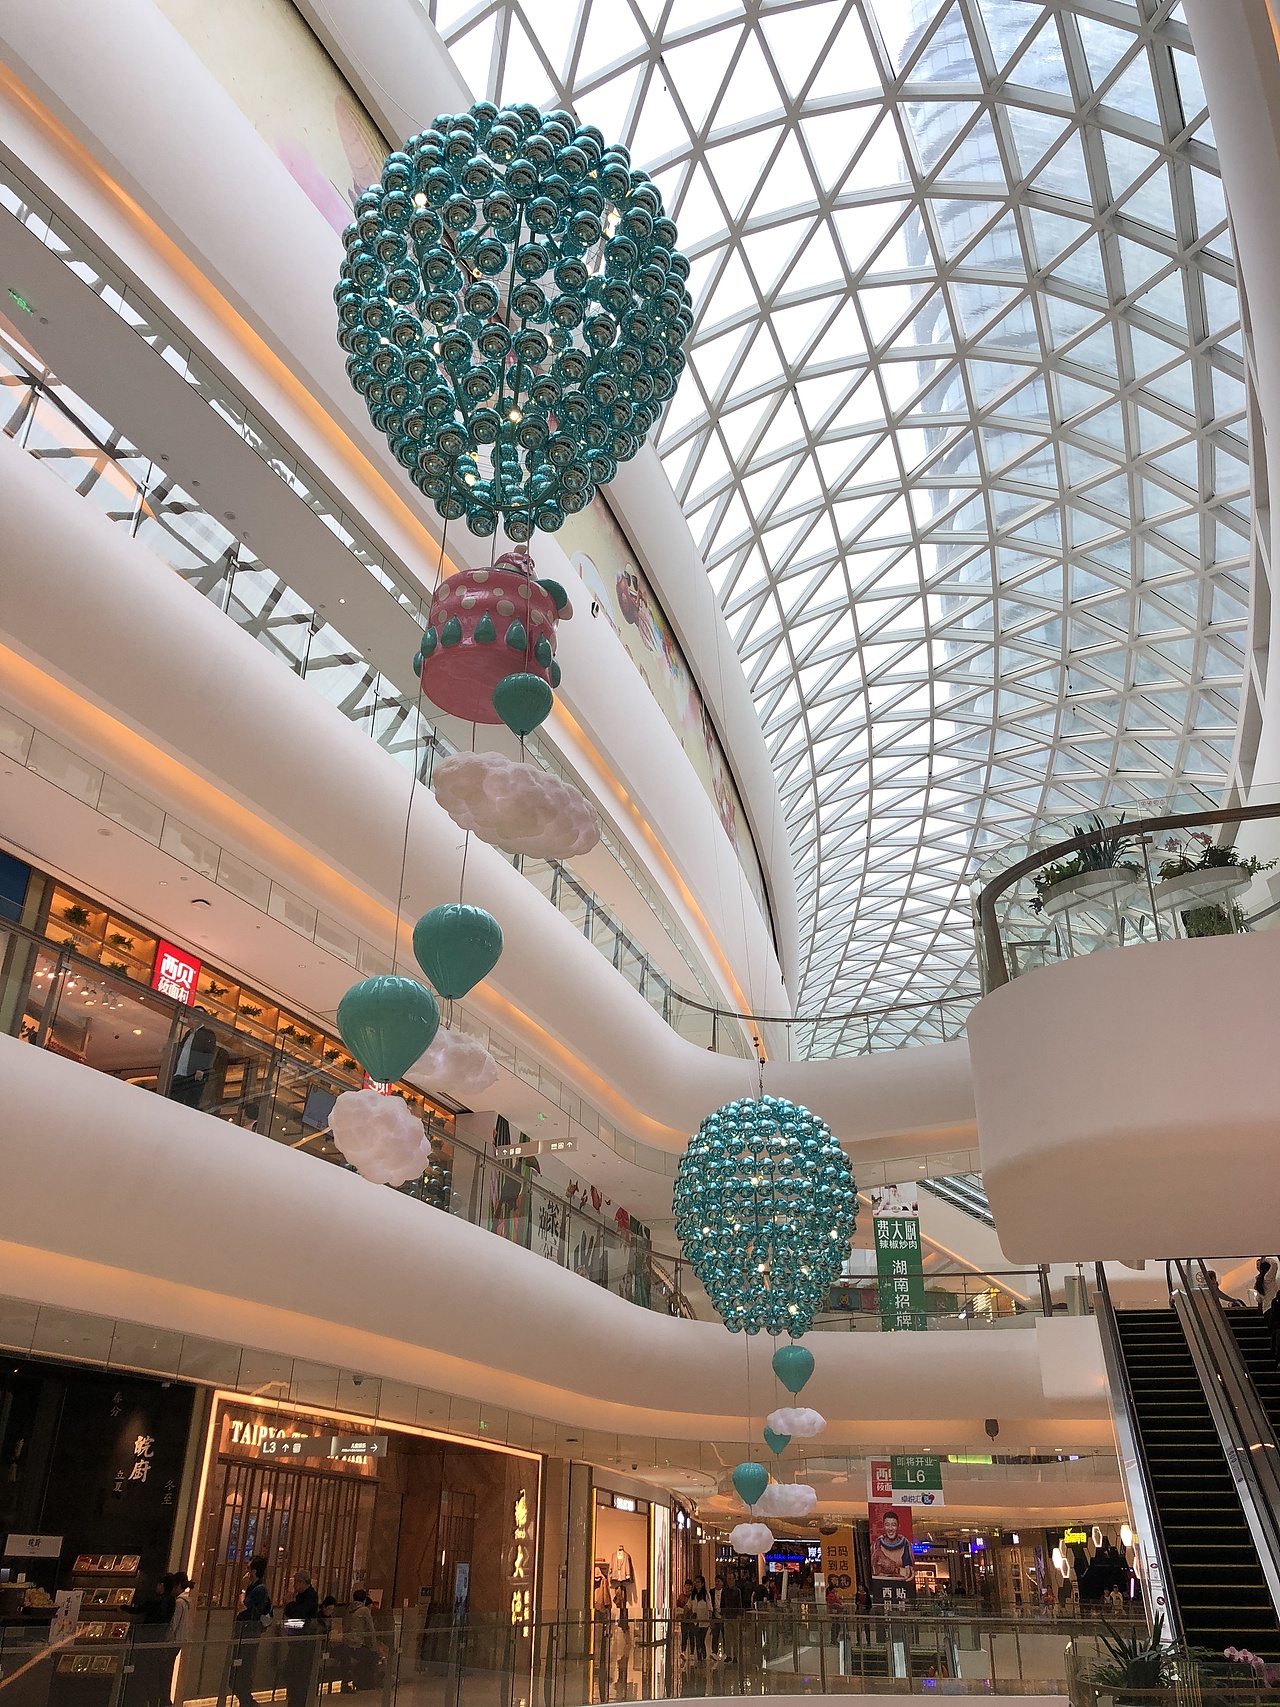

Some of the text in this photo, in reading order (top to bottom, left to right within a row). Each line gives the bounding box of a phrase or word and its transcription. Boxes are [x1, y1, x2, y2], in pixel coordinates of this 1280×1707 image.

[160, 953, 196, 989] 西贝
[877, 1220, 917, 1240] 费大厨
[879, 1239, 918, 1250] 辣椒炒肉
[892, 1260, 913, 1331] 湖南招牌
[262, 1441, 277, 1453] L3
[896, 1456, 935, 1467] 即将开业
[876, 1467, 892, 1481] 西
[906, 1469, 926, 1483] L6
[826, 1545, 849, 1557] 扫码
[828, 1560, 849, 1571] 到店
